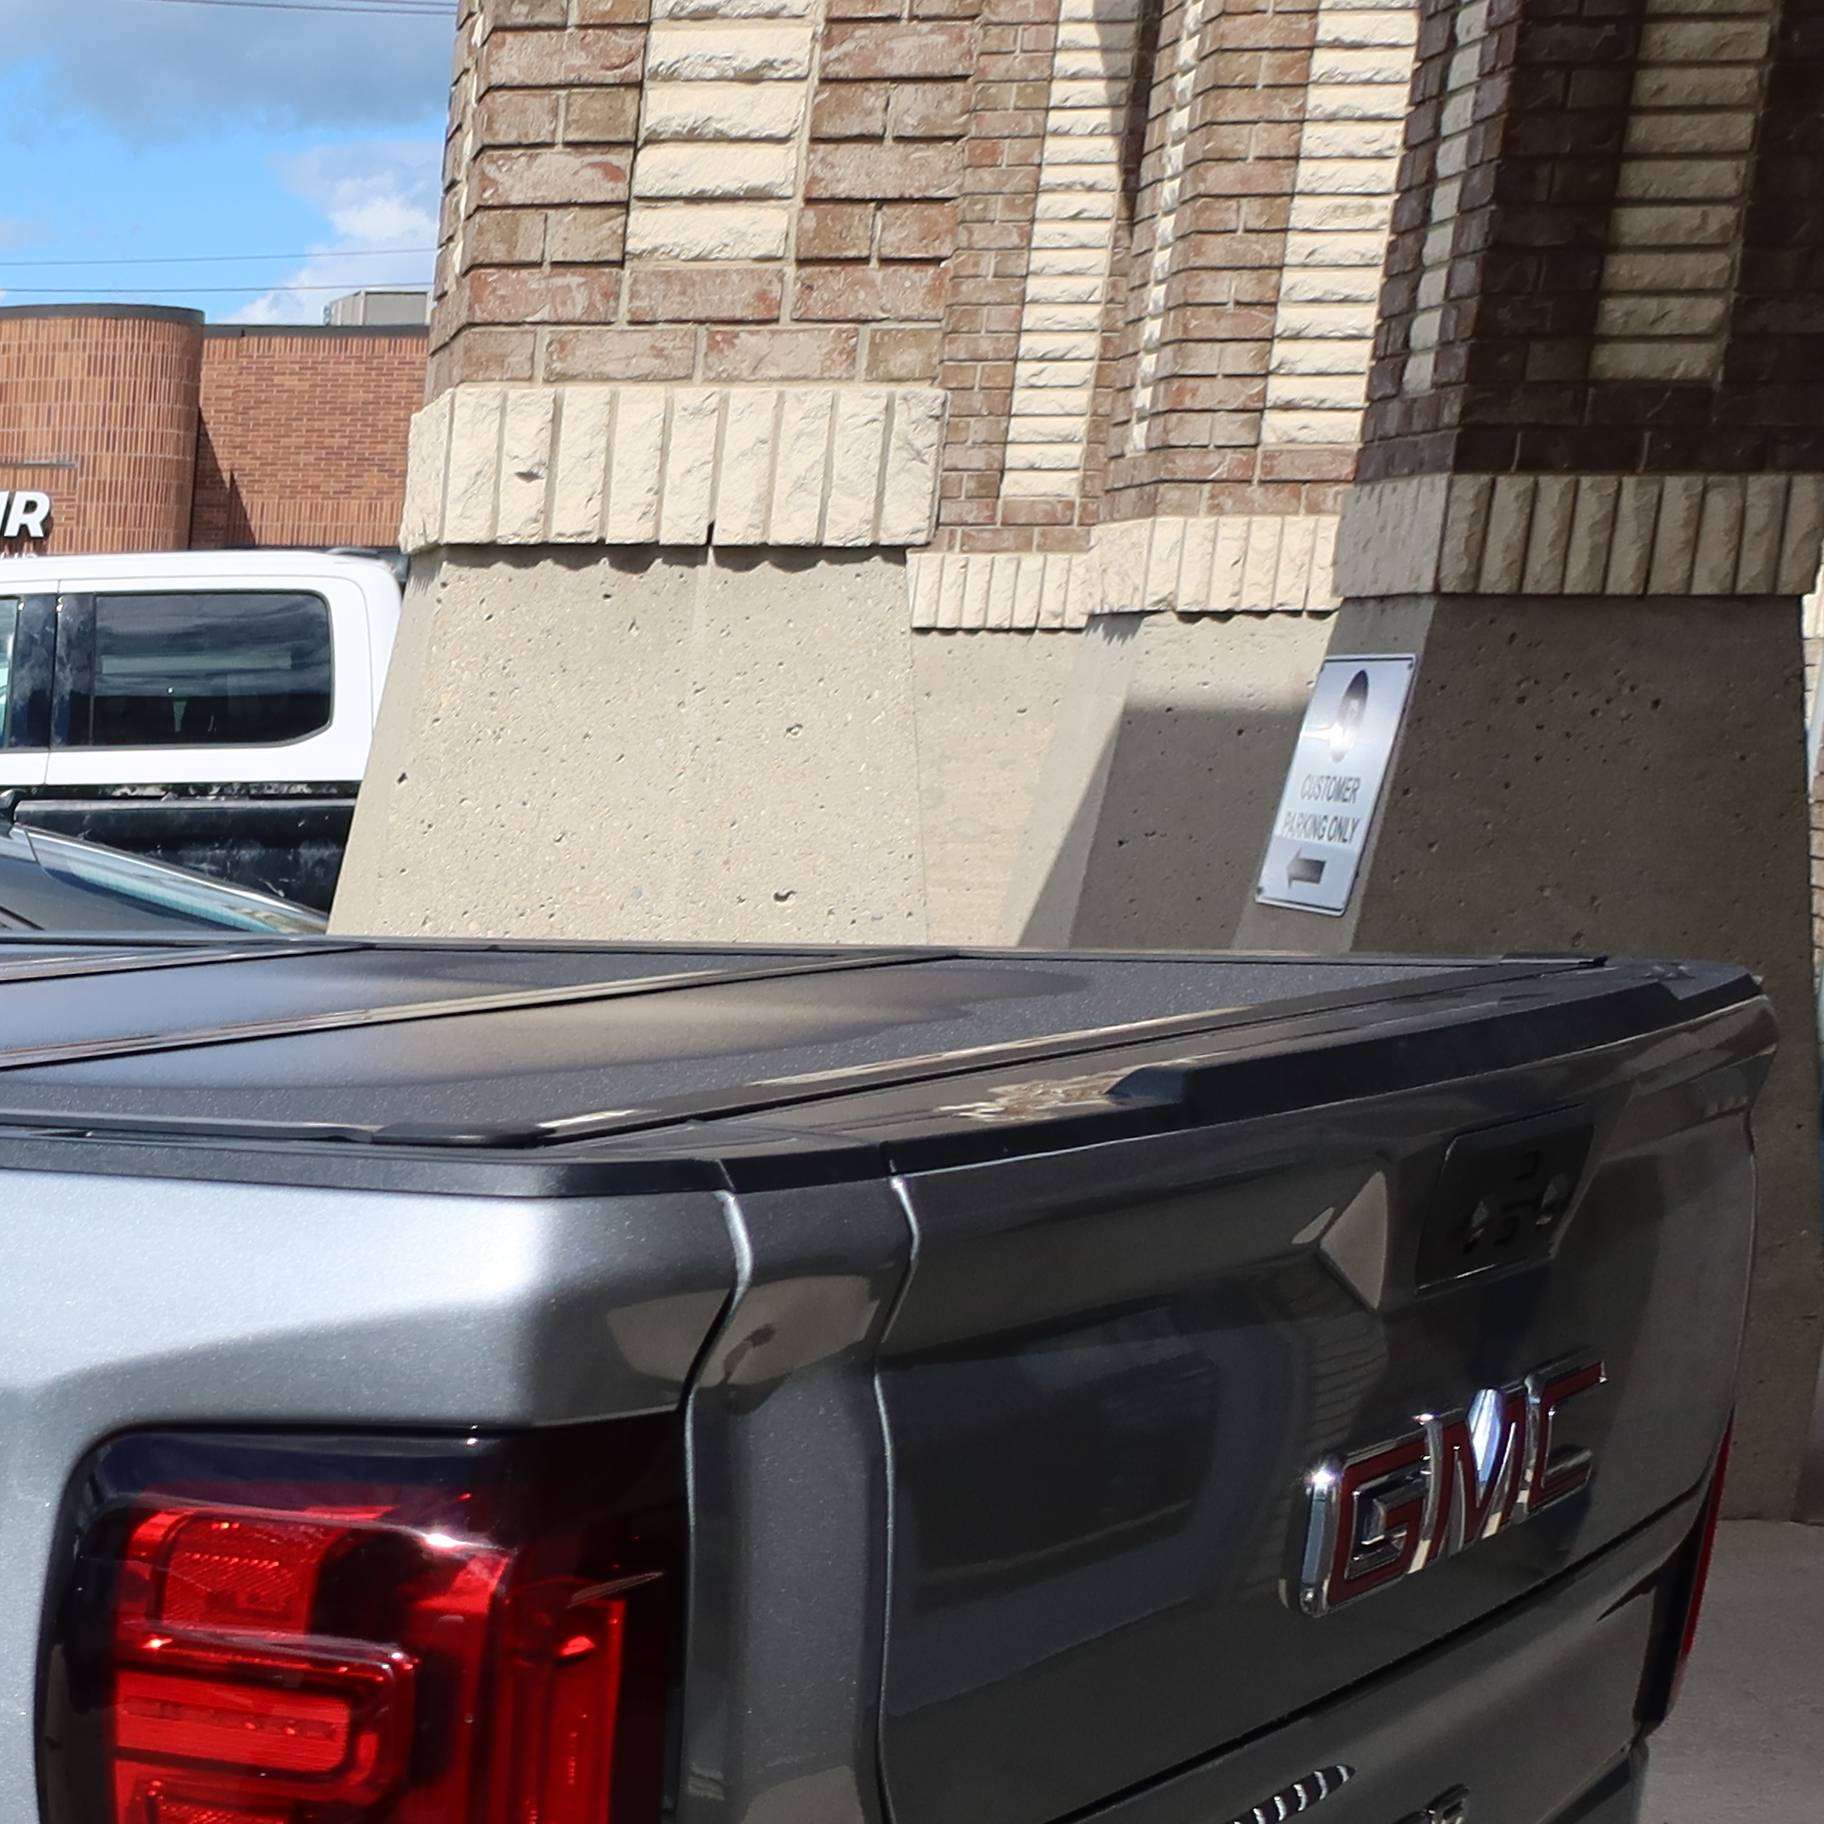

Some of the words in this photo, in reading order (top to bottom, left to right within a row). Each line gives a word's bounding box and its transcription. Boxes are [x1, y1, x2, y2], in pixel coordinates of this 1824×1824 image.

[1300, 774, 1361, 804] CUSTOMER
[1282, 810, 1327, 841] PARKING
[1328, 814, 1361, 844] ONLY
[1301, 1352, 1605, 1618] GMC
